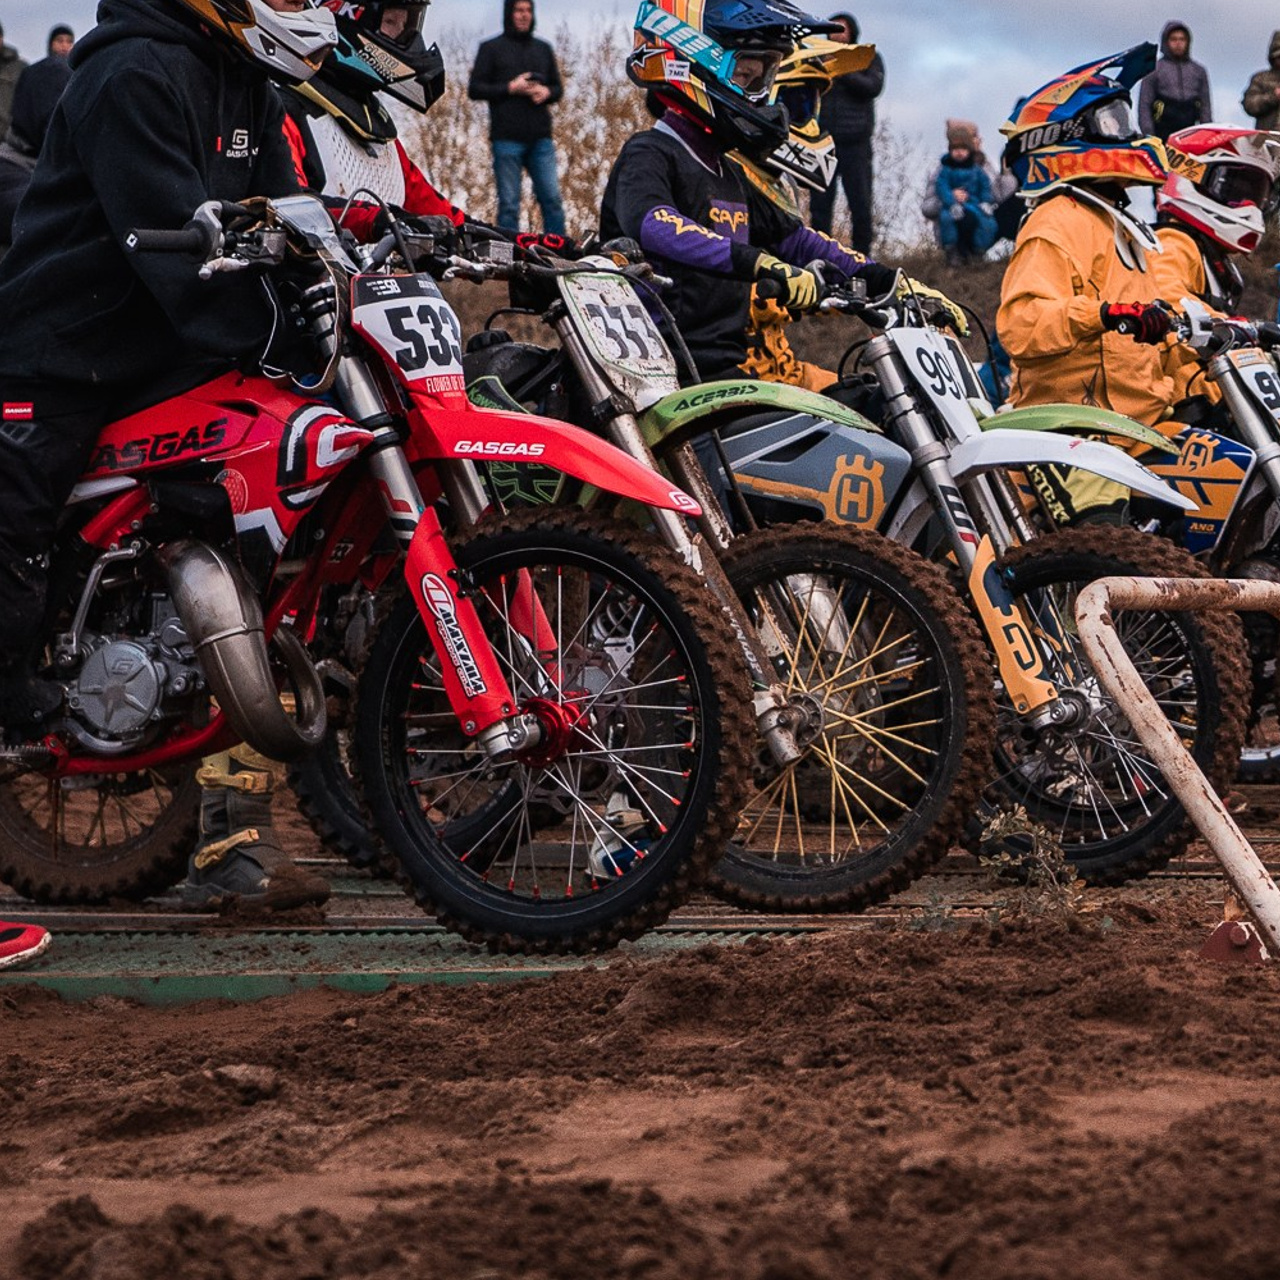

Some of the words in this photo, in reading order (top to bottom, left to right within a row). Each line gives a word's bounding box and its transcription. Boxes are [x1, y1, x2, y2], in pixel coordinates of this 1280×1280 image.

[1019, 116, 1086, 154] 100%
[383, 304, 463, 373] 533
[673, 383, 759, 413] ACERBIS
[92, 417, 228, 470] ASGAS
[453, 440, 546, 457] GASGAS
[438, 606, 487, 696] MAXIMA
